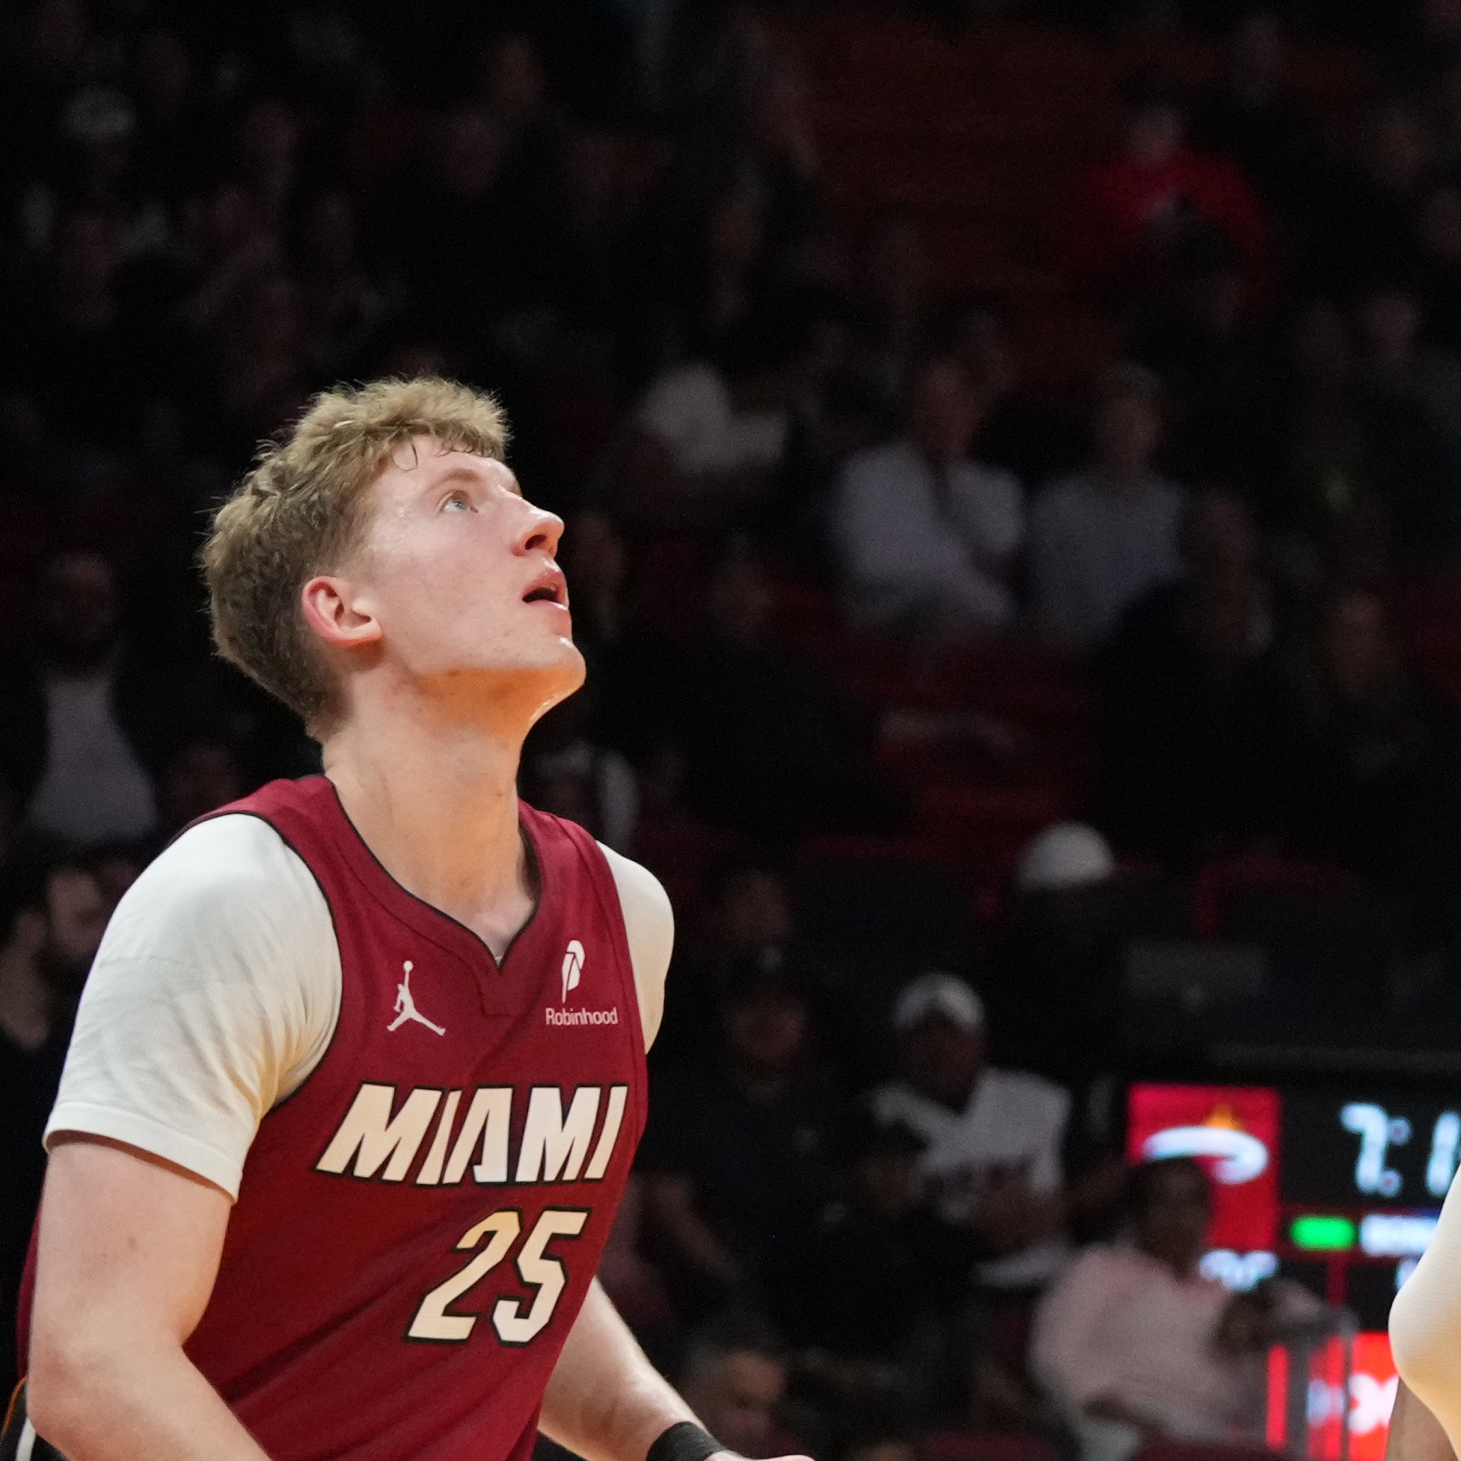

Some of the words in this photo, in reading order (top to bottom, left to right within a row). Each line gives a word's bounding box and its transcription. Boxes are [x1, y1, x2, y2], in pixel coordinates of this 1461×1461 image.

[545, 1006, 618, 1026] Robinhood
[315, 1081, 629, 1186] MIAMI
[402, 1206, 591, 1346] 25
